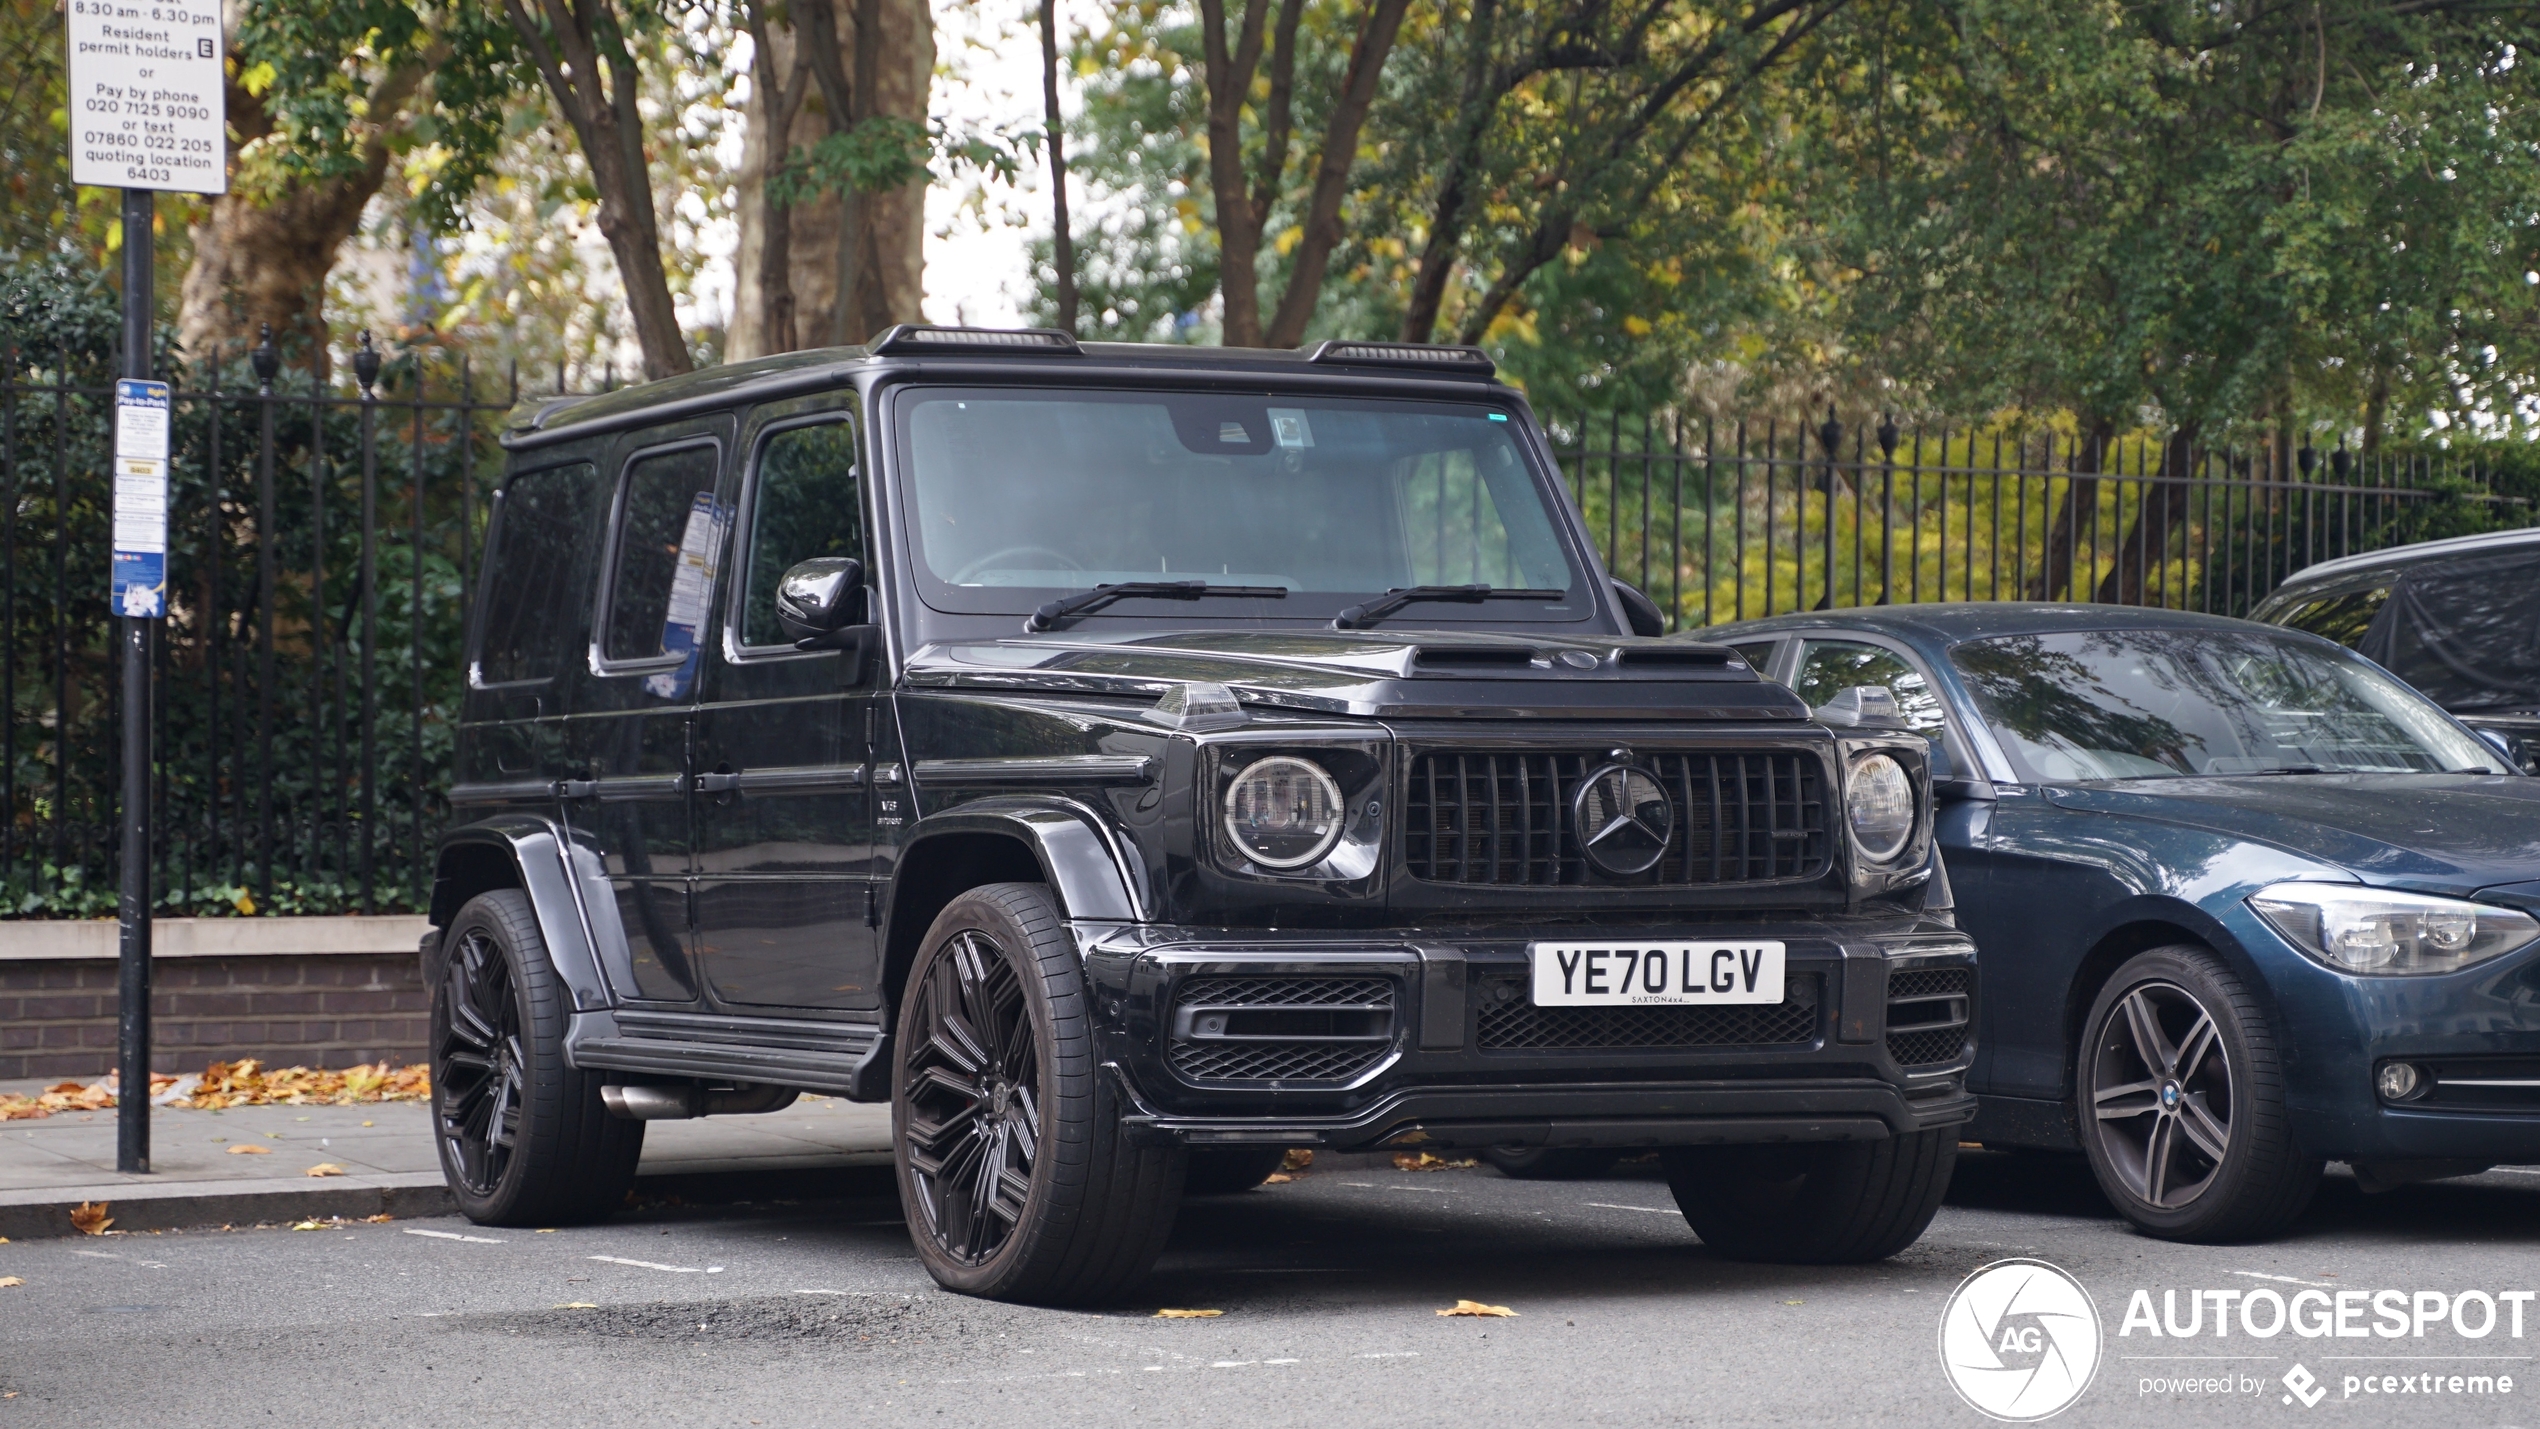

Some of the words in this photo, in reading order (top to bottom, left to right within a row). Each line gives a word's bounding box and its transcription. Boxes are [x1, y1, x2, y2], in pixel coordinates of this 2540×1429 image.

[75, 2, 113, 16] 8.30
[116, 7, 139, 18] am
[151, 8, 188, 23] 6.30
[192, 13, 215, 26] pm
[102, 25, 170, 43] Resident
[79, 41, 130, 56] permit
[136, 44, 193, 61] holders
[139, 67, 155, 78] or
[96, 83, 123, 98] Pay
[129, 85, 147, 99] by
[153, 89, 199, 103] phone
[86, 98, 119, 113] 020
[126, 101, 160, 116] 7125
[166, 105, 210, 120] 9090
[122, 120, 137, 131] or
[144, 120, 175, 134] text
[84, 131, 138, 147] 07860
[144, 134, 175, 150] 022
[181, 138, 212, 152] 205
[86, 149, 145, 166] quoting
[150, 152, 212, 169] location
[127, 167, 170, 182] 6403
[1556, 949, 1668, 995] YE70
[1682, 949, 1763, 994] LGV
